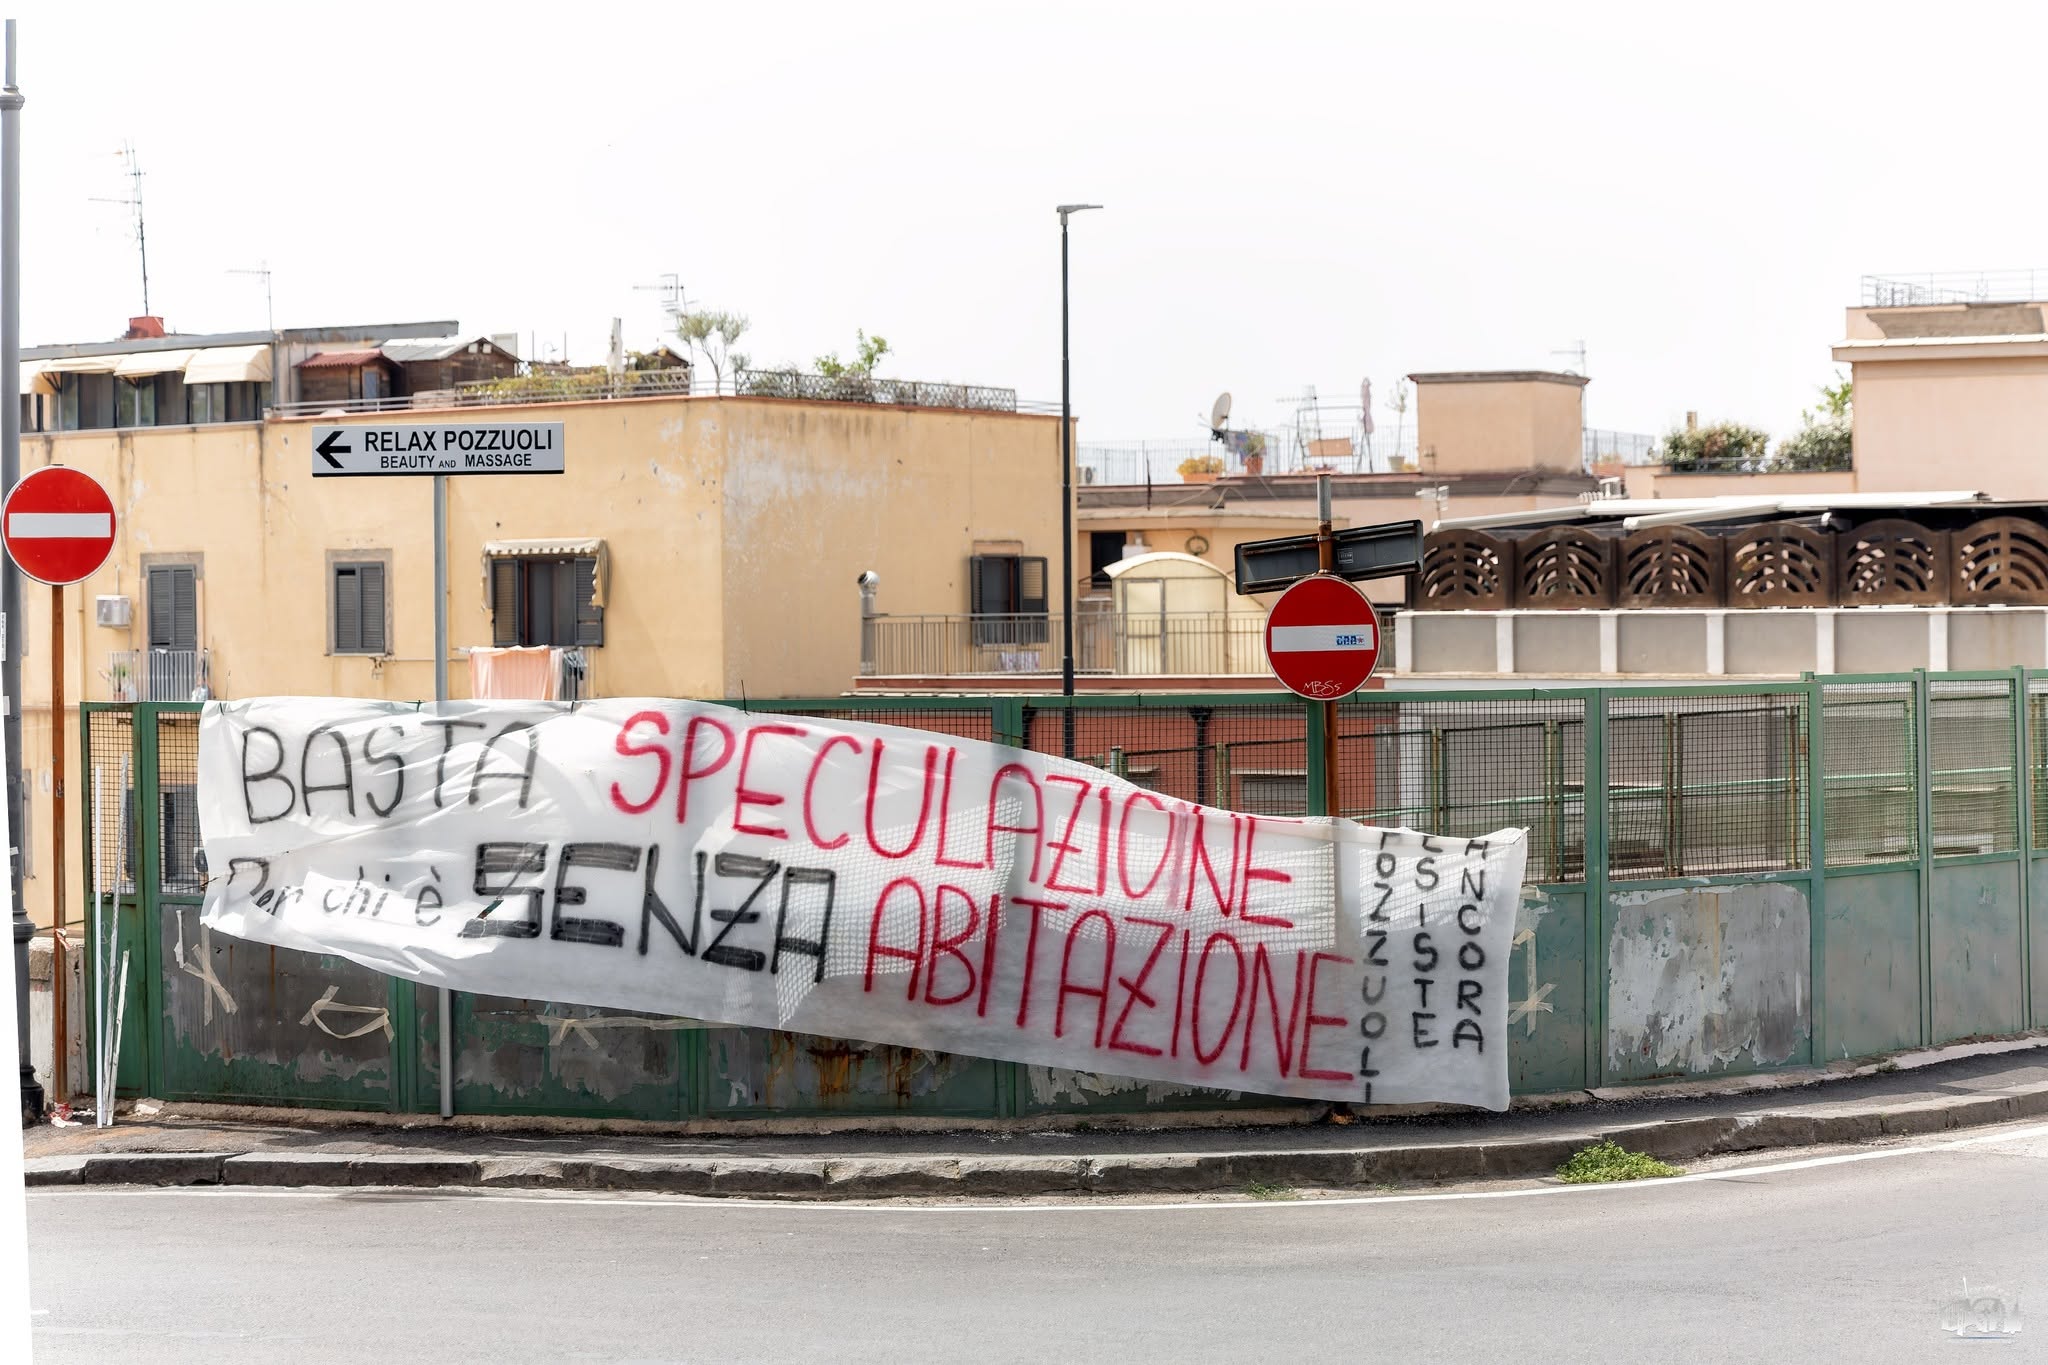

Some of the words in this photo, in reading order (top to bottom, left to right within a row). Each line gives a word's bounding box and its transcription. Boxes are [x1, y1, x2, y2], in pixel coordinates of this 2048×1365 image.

[364, 431, 437, 452] RELAX
[444, 429, 552, 451] POZZUOLI
[380, 455, 435, 469] BEAUTY
[438, 459, 456, 469] AND
[465, 453, 532, 467] MASSAGE
[241, 718, 540, 824] BASTA
[610, 710, 1302, 929] SPECULAZIONE
[323, 865, 391, 917] chi
[415, 865, 443, 926] è
[457, 842, 835, 983] SENZA
[863, 876, 1355, 1080] ABITAZIONE
